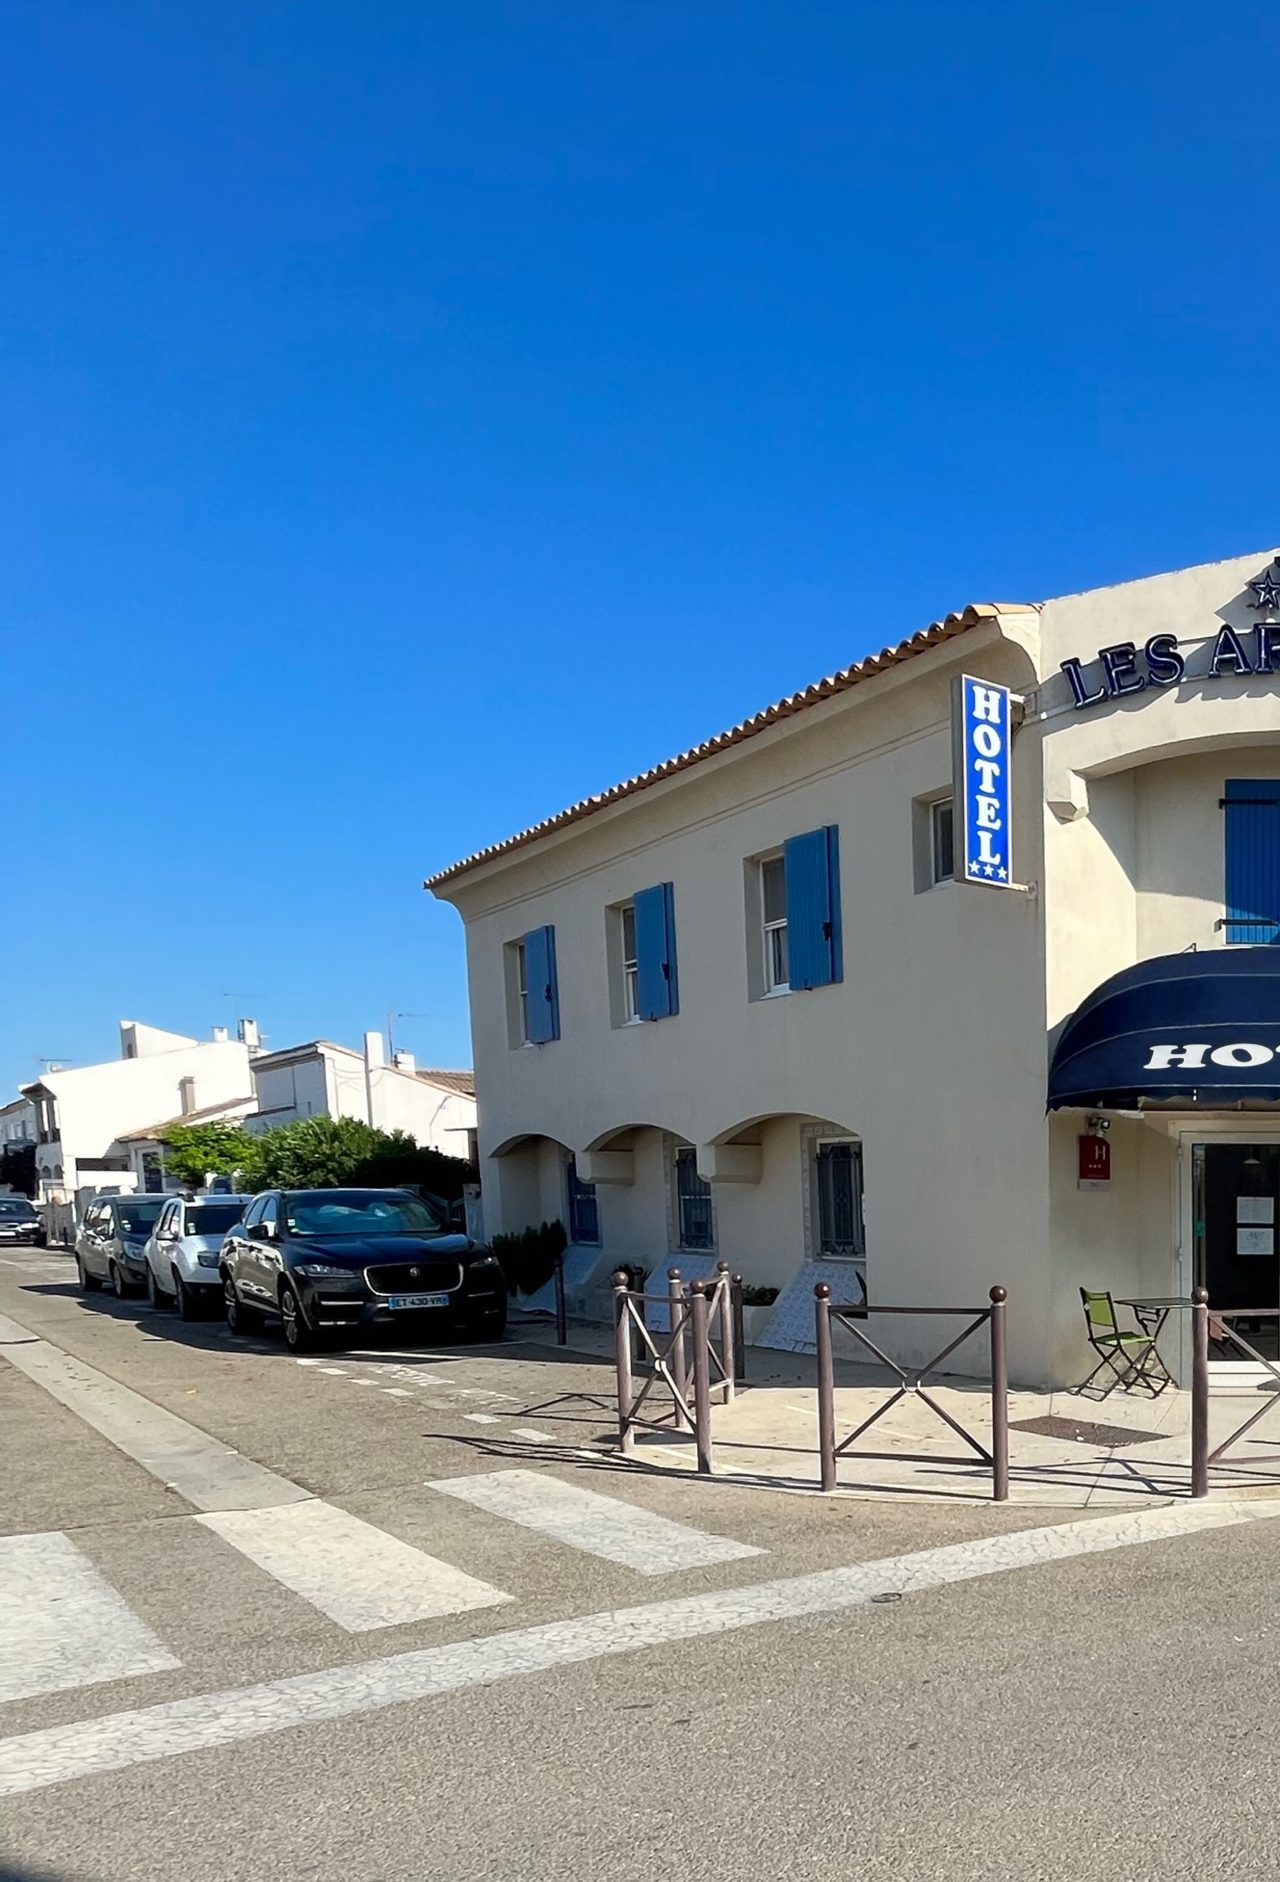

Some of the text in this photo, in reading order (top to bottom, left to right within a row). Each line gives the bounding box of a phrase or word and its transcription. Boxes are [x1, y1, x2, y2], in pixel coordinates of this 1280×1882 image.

[1061, 633, 1186, 710] LES
[972, 685, 1002, 865] HOTEL
[1095, 1145, 1106, 1161] H
